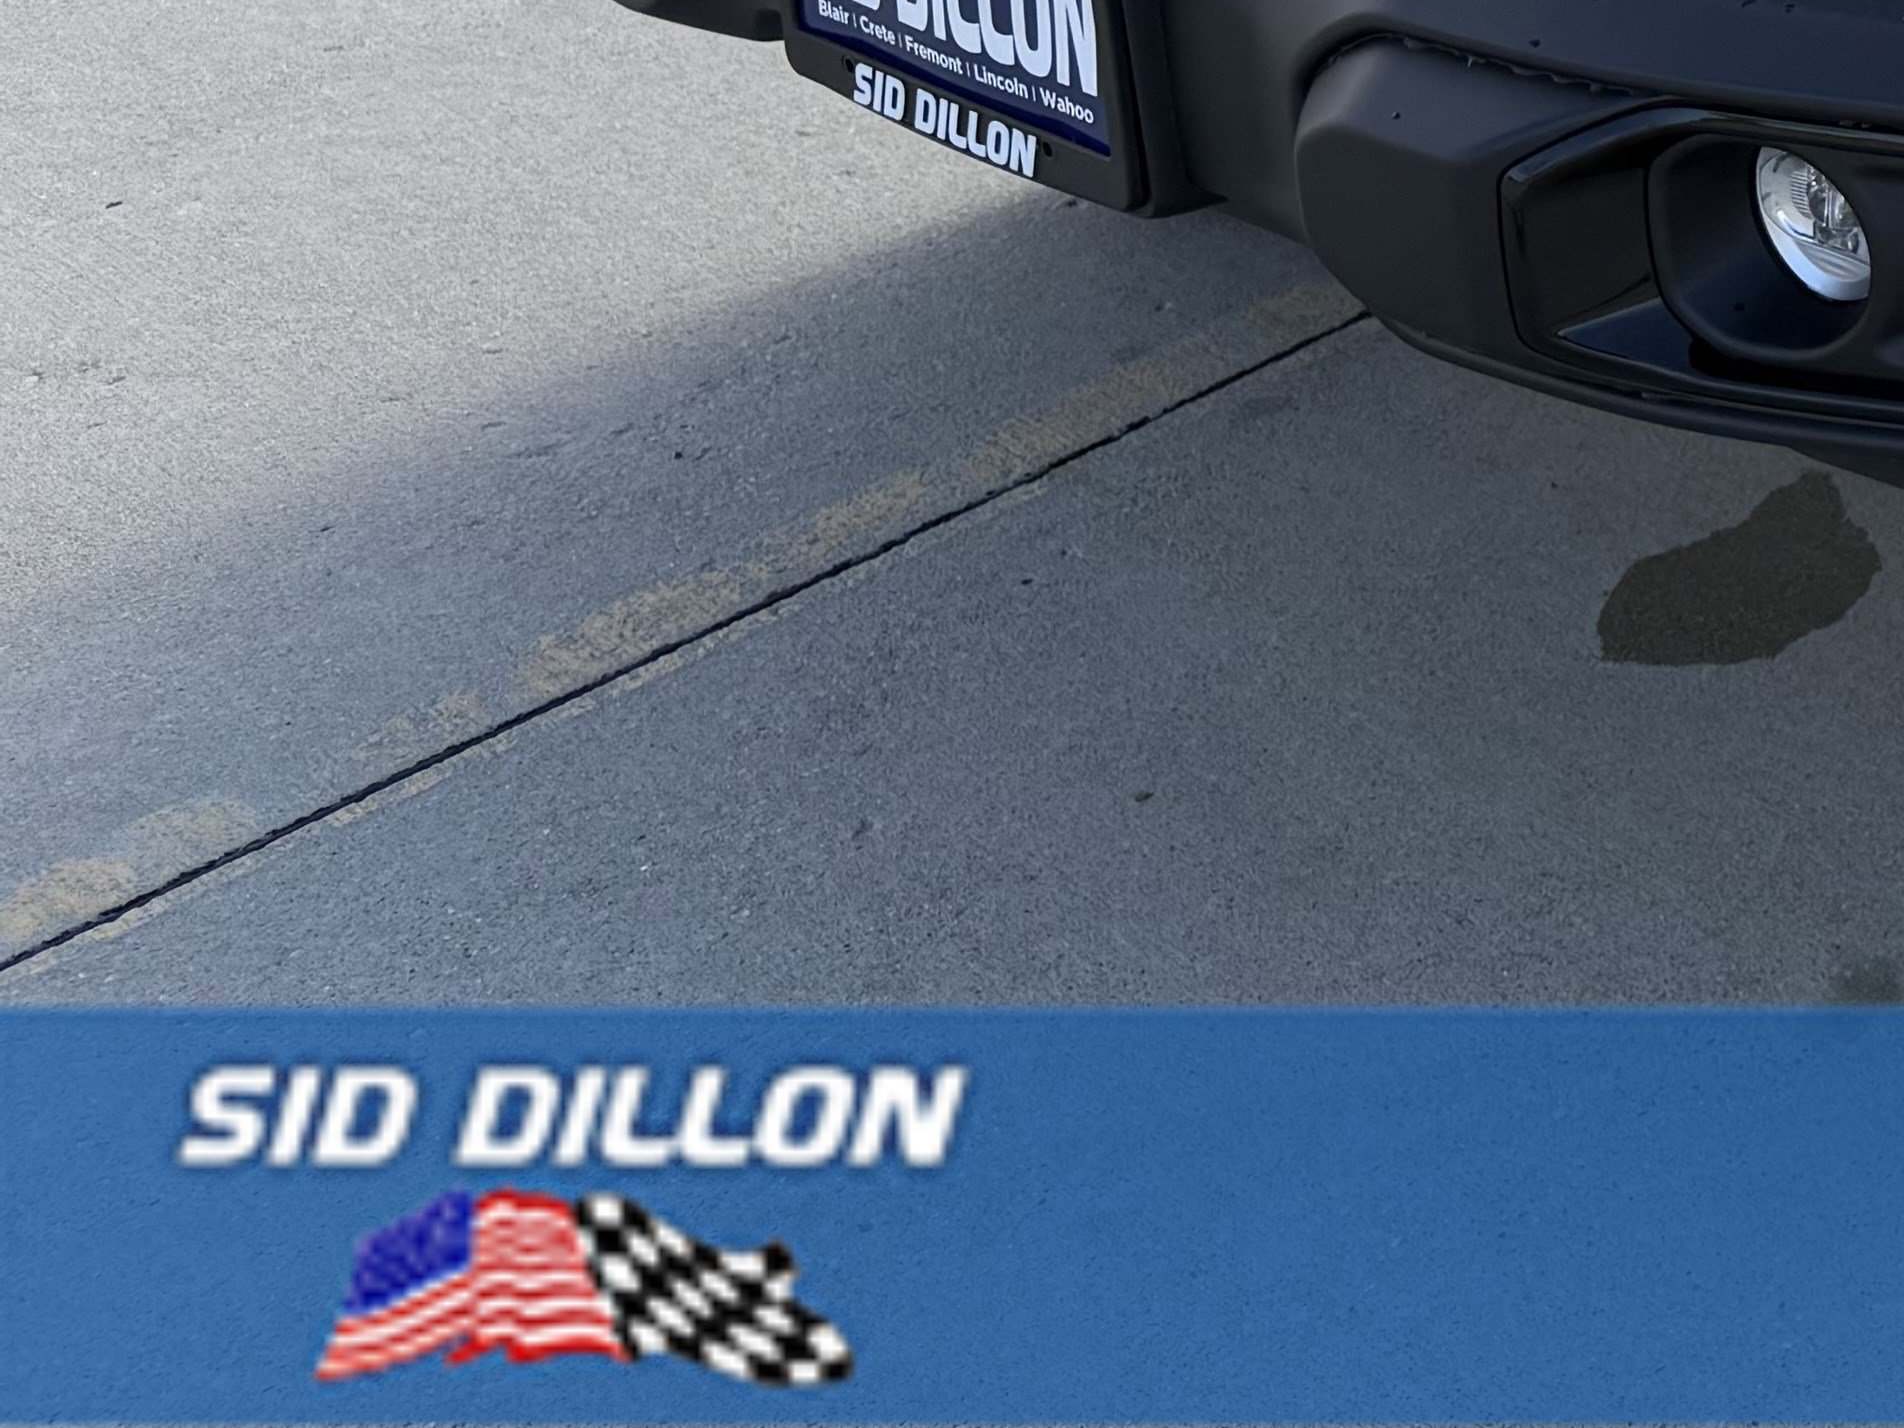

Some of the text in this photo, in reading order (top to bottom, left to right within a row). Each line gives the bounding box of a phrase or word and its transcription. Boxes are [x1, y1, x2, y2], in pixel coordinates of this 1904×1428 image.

[852, 62, 1038, 178] SID DILLON
[860, 15, 896, 45] Crete
[905, 35, 963, 76] Fremont
[975, 63, 1029, 100] Lincoln
[1039, 87, 1094, 125] Wahoo
